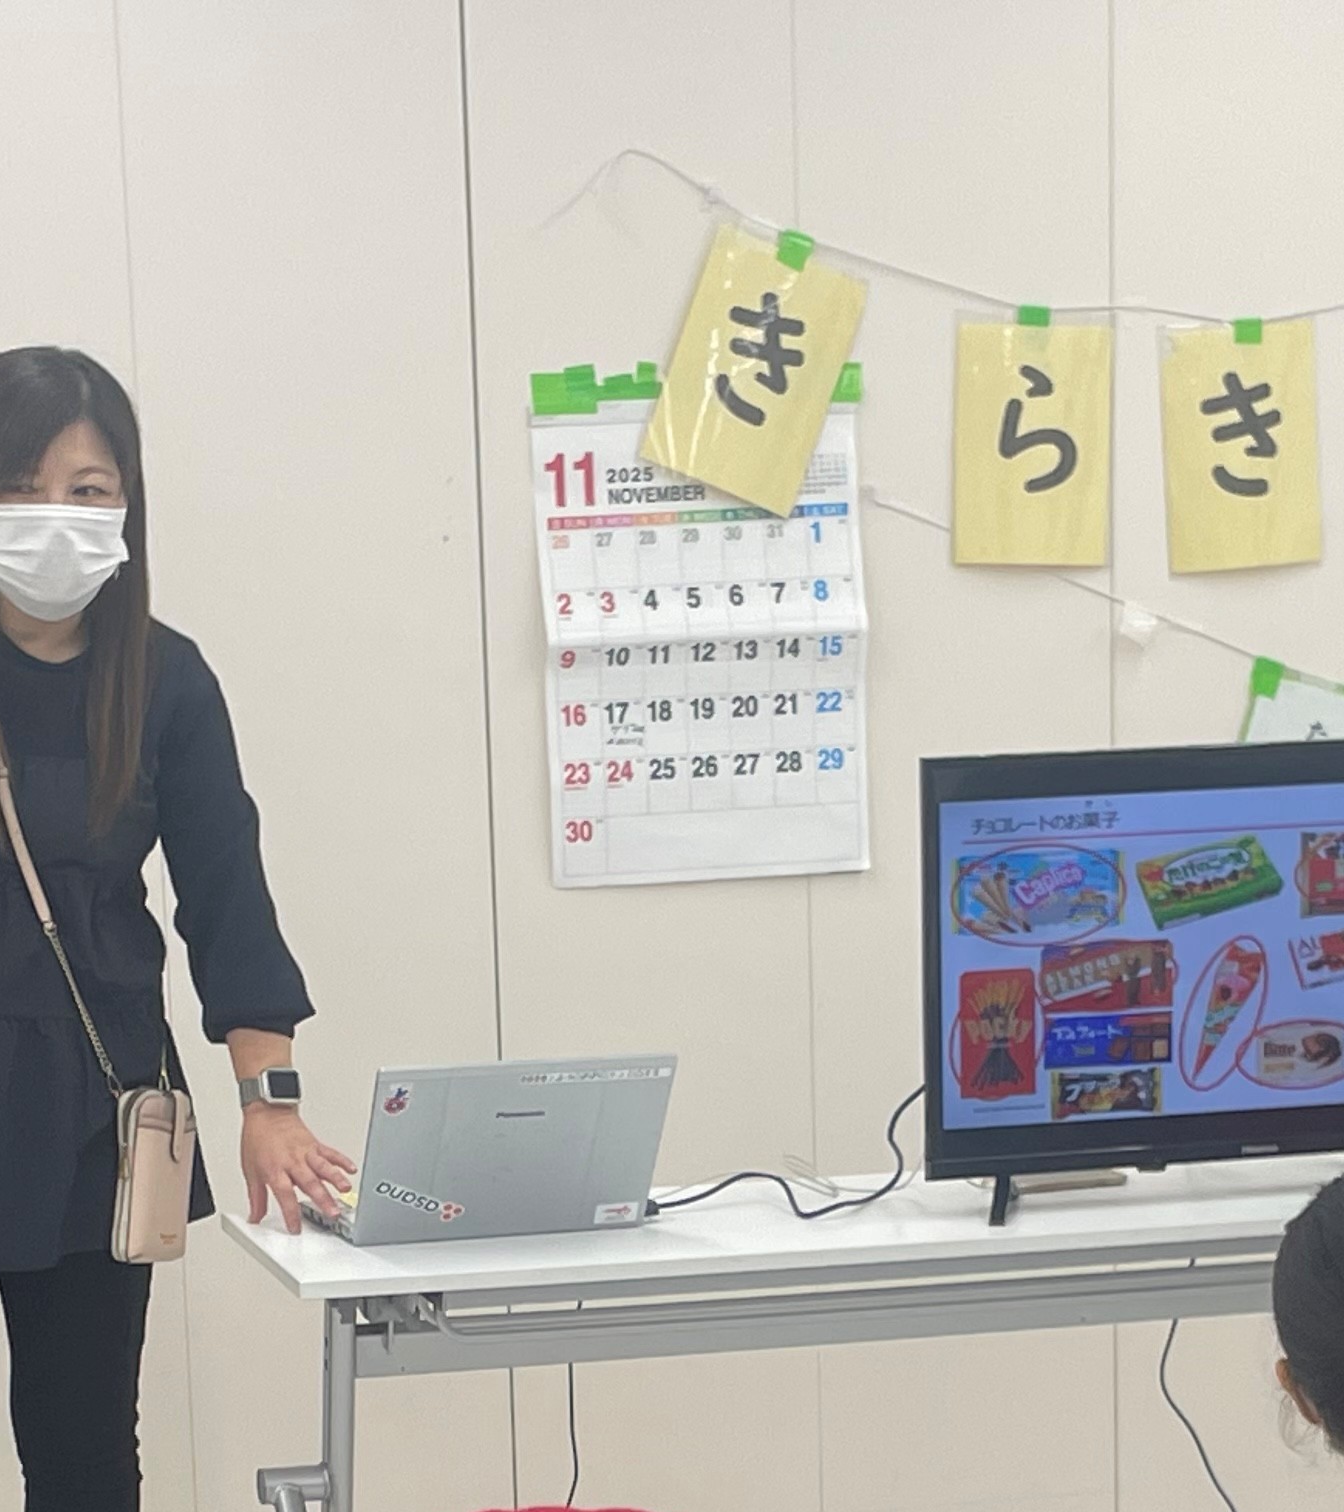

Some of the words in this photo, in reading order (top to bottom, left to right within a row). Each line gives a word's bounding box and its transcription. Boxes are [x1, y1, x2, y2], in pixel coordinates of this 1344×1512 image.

[715, 292, 805, 427] き
[999, 365, 1077, 493] ら
[1199, 371, 1281, 497] き
[544, 452, 596, 507] 11
[606, 467, 654, 483] 2025
[607, 485, 705, 504] NOVEMBER
[595, 532, 613, 547] 27
[723, 525, 743, 541] 30
[766, 524, 785, 539] 31
[810, 521, 821, 543] 1
[558, 593, 574, 615] 2
[600, 591, 617, 613] 3
[643, 589, 660, 611] 4
[686, 587, 702, 609] 5
[728, 584, 744, 606] 6
[770, 582, 786, 604] 7
[813, 579, 829, 601] 8
[560, 650, 576, 669] 9
[605, 646, 631, 667] 10
[647, 645, 672, 664] 11
[691, 642, 716, 662] 12
[733, 639, 758, 661] 13
[776, 638, 800, 659] 14
[819, 635, 843, 657] 15
[560, 703, 587, 727] 16
[604, 701, 630, 725] 17
[646, 700, 672, 722] 18
[690, 697, 715, 720] 19
[731, 695, 758, 718] 20
[774, 693, 798, 715] 21
[816, 691, 842, 714] 22
[564, 762, 591, 785] 23
[606, 759, 634, 783] 24
[649, 757, 676, 780] 25
[692, 755, 719, 779] 26
[733, 753, 760, 776] 27
[775, 750, 803, 773] 28
[817, 748, 845, 771] 29
[565, 820, 593, 843] 30
[376, 1182, 439, 1212] asana
